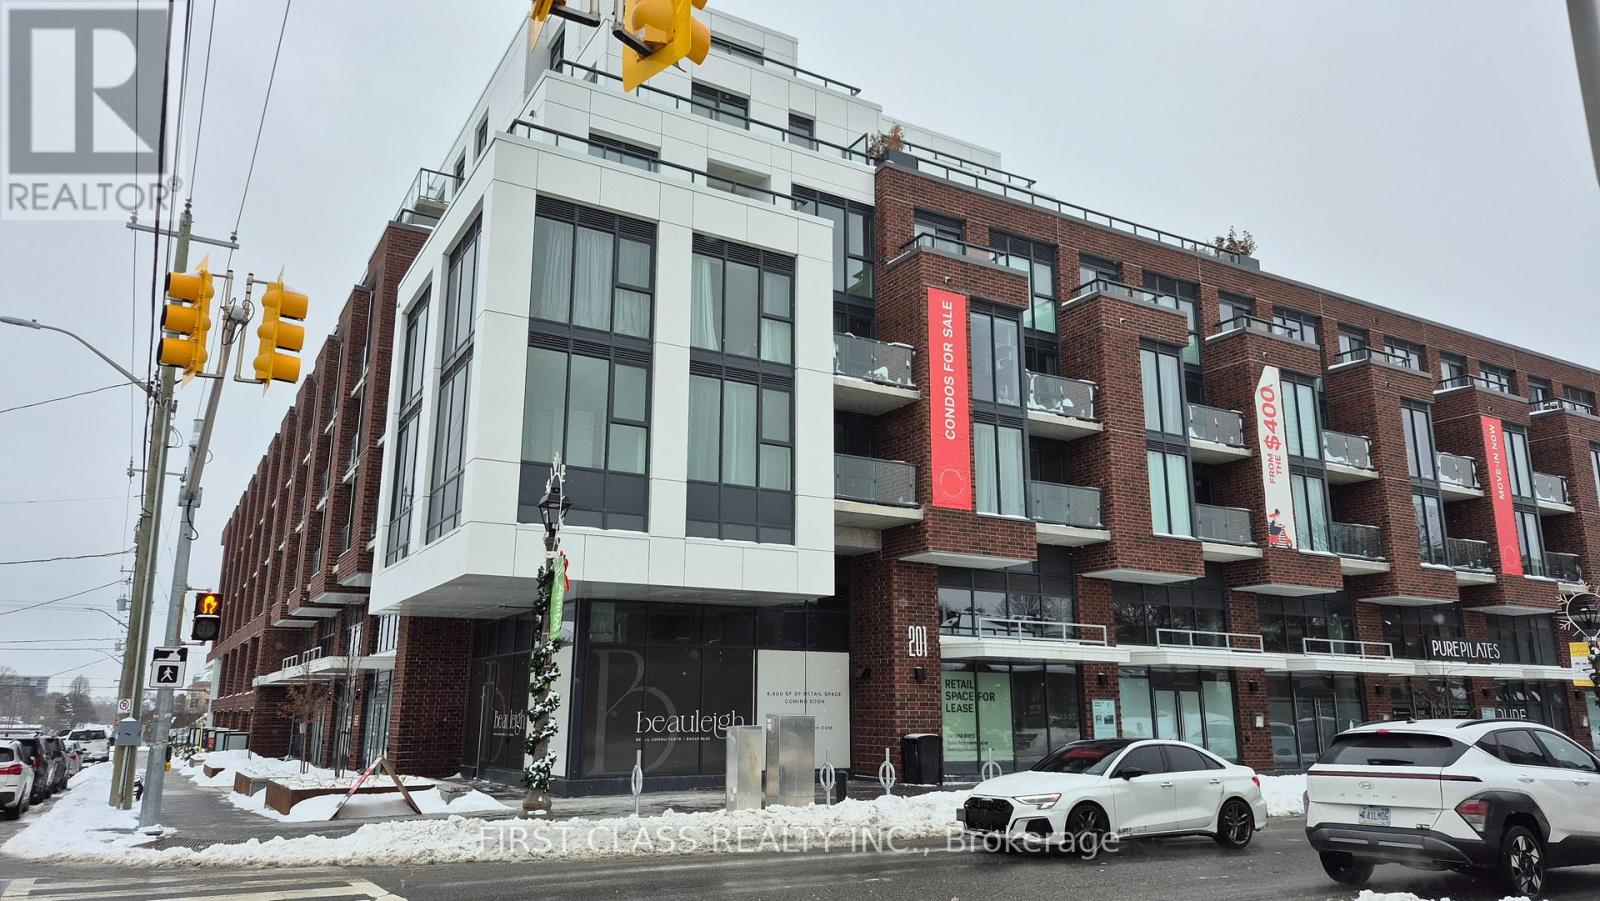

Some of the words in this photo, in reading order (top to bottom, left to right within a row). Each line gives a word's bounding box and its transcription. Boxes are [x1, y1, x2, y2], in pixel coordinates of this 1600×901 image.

[942, 300, 953, 338] SALE
[943, 342, 954, 372] FOR
[944, 376, 956, 440] CONDOS
[1488, 424, 1501, 450] NOW
[1268, 453, 1276, 484] FROM
[1492, 453, 1505, 500] MOVE-IN
[908, 625, 927, 657] 201
[944, 679, 975, 689] RETAIL
[945, 691, 975, 701] SPACE
[978, 692, 996, 701] FOR
[945, 703, 974, 713] LEASE
